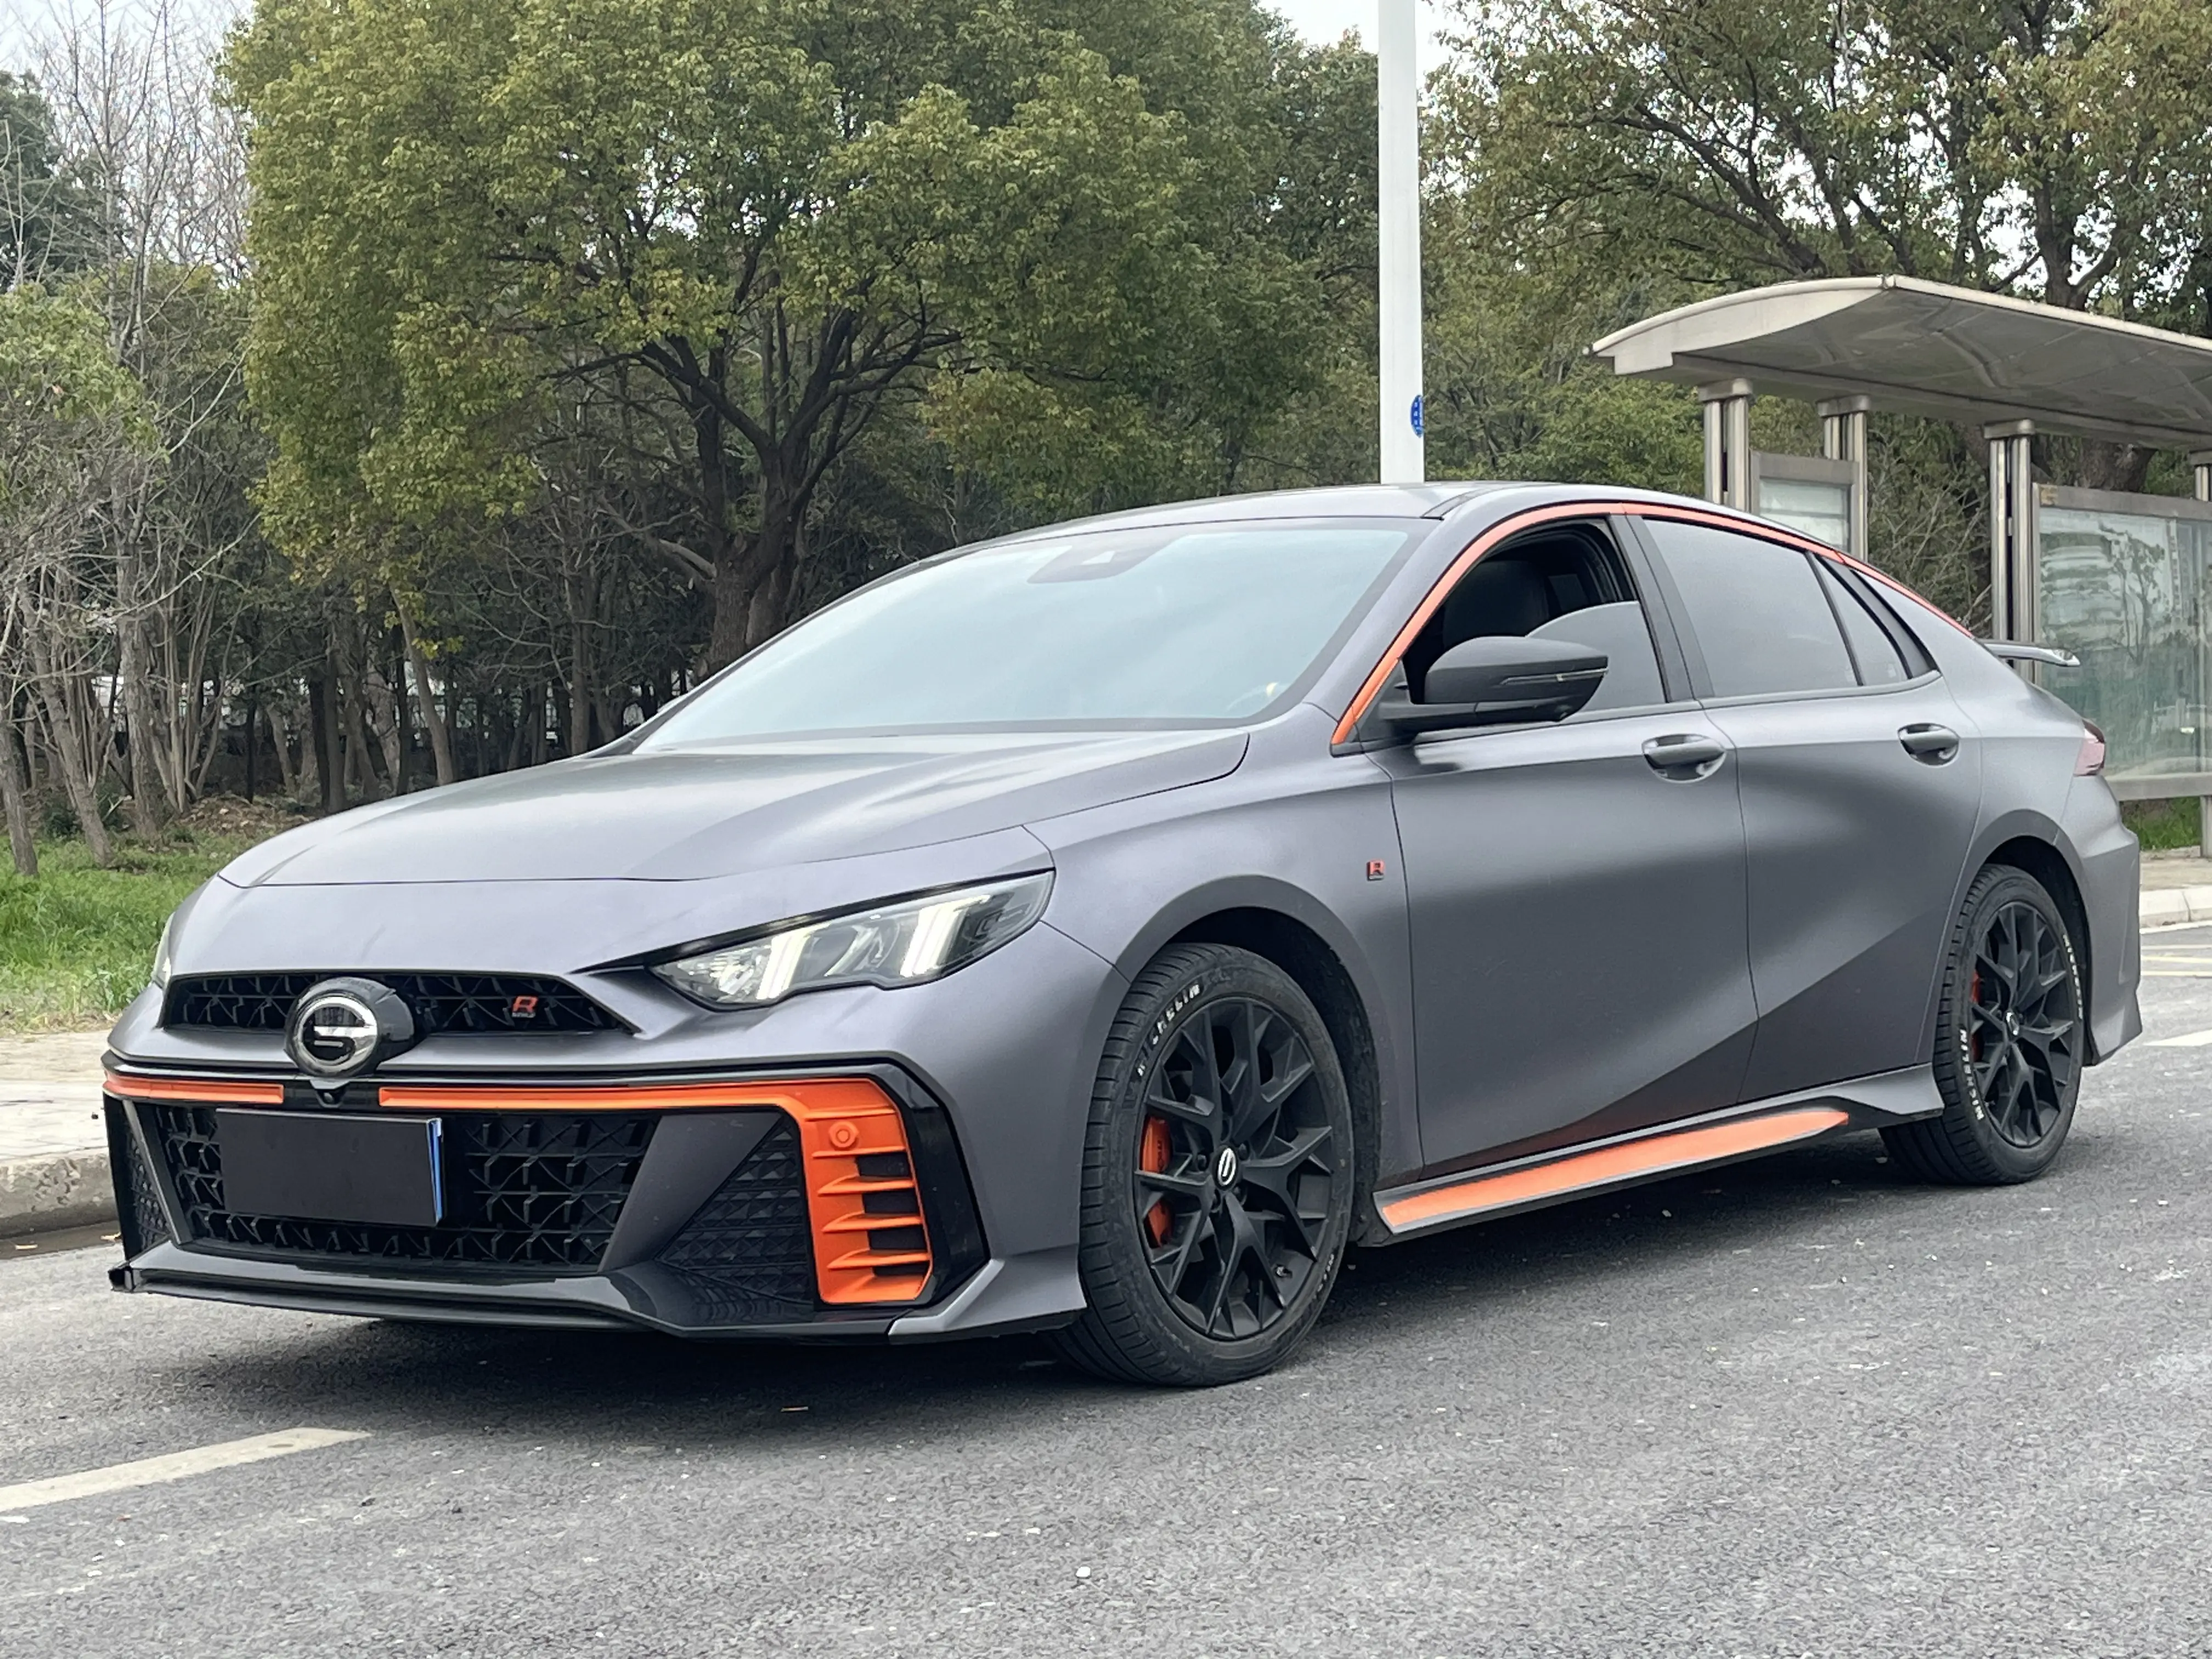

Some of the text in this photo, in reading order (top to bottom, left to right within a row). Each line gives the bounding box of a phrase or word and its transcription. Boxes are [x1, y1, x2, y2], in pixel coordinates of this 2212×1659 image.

[513, 996, 538, 1013] R
[1137, 984, 1200, 1076] MHELIN
[1959, 1029, 1985, 1120] MICHELIN
